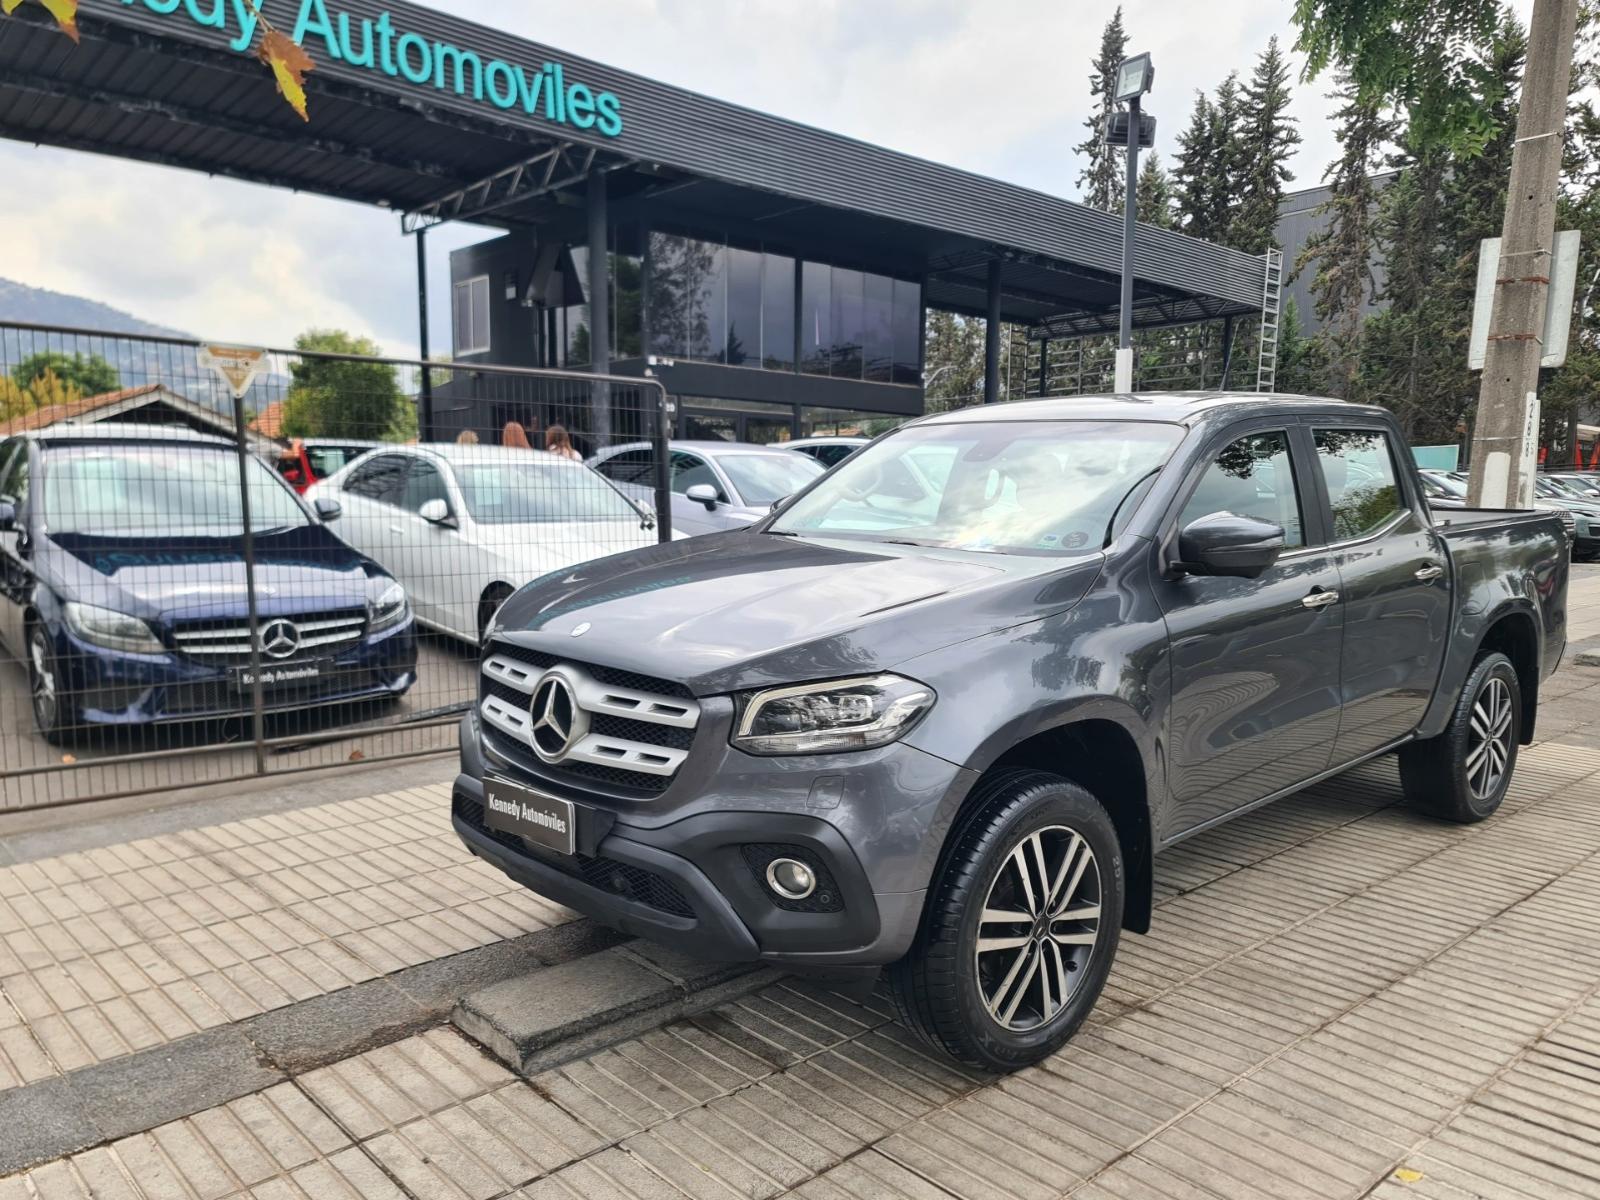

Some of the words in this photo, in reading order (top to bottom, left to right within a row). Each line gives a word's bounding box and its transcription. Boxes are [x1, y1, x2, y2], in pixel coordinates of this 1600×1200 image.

[292, 0, 623, 137] Automoviles
[488, 792, 521, 821] Kennedy
[521, 803, 566, 833] Automóviles
